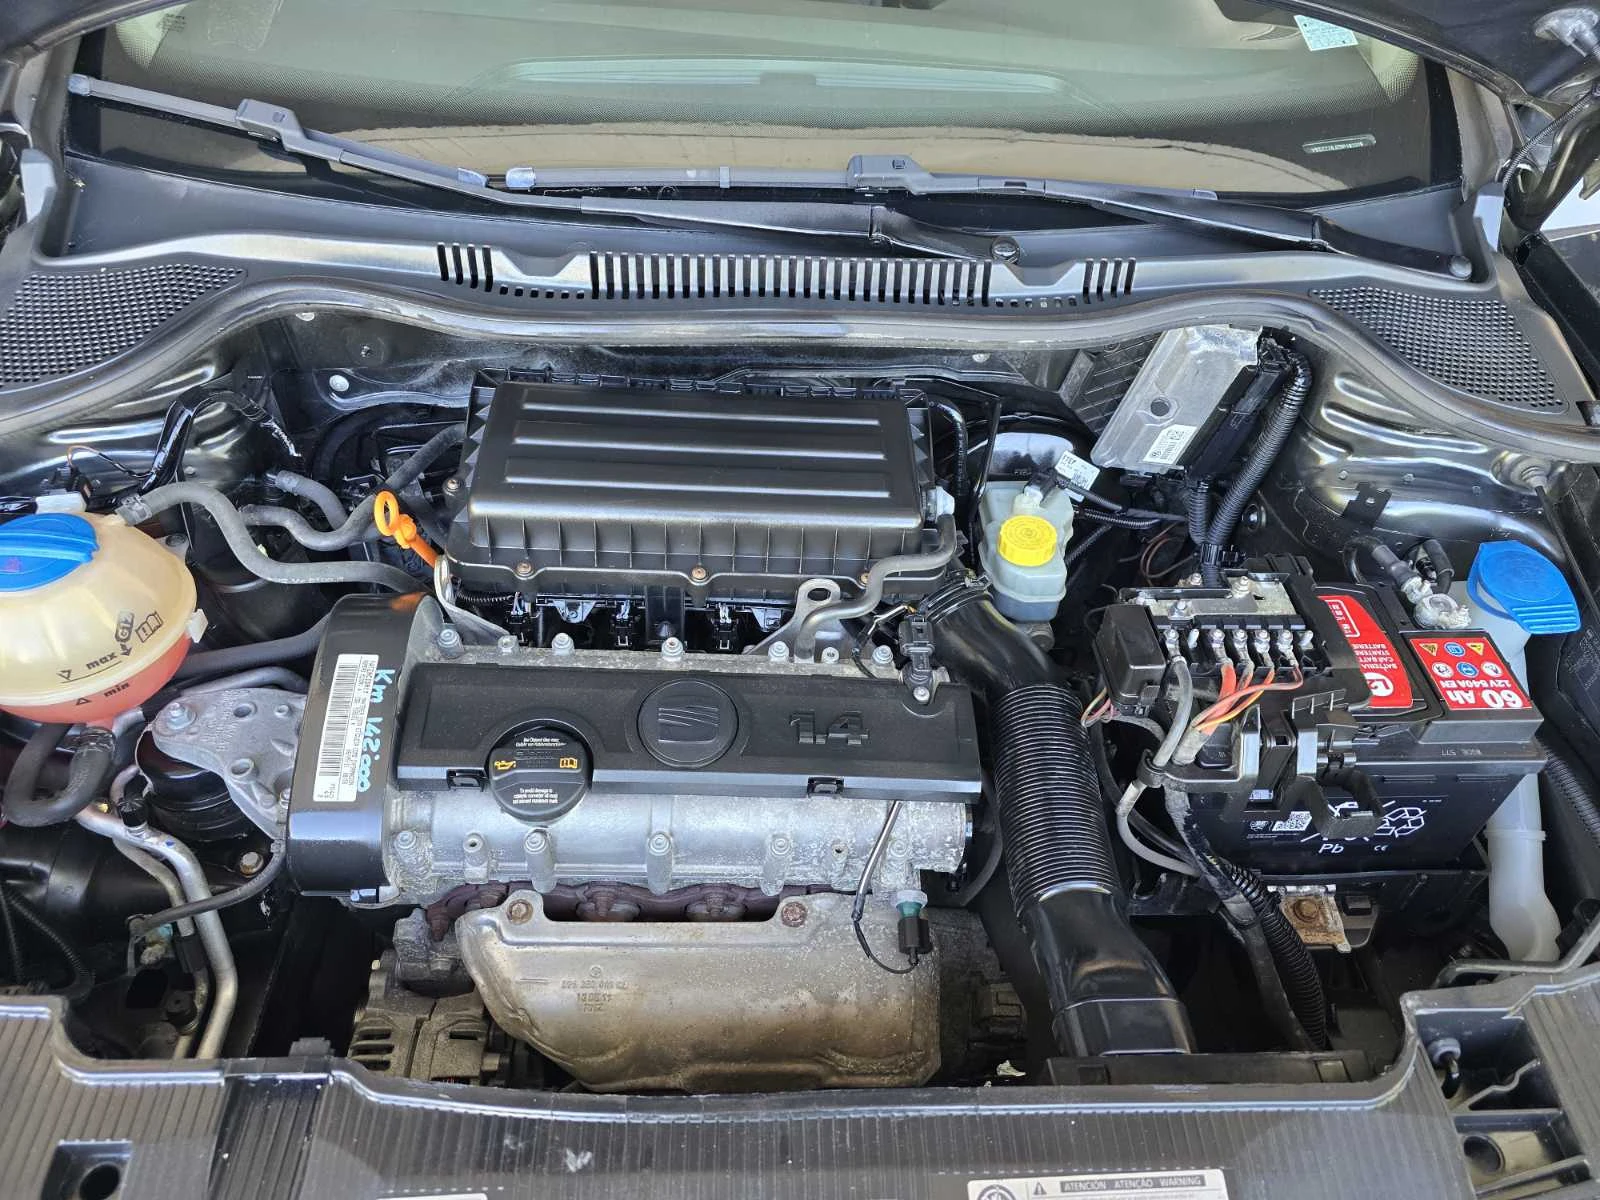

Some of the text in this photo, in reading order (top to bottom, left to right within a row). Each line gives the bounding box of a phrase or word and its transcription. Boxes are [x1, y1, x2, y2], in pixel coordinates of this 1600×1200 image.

[85, 652, 118, 671] max
[104, 682, 130, 697] min
[1440, 679, 1457, 688] EN
[1489, 679, 1512, 688] 12V
[1446, 689, 1524, 708] 60 Ah
[789, 709, 869, 746] 1.4
[1318, 843, 1345, 855] Pb
[1063, 1178, 1107, 1192] ATENCIÓN
[1160, 1174, 1202, 1188] WARNING
